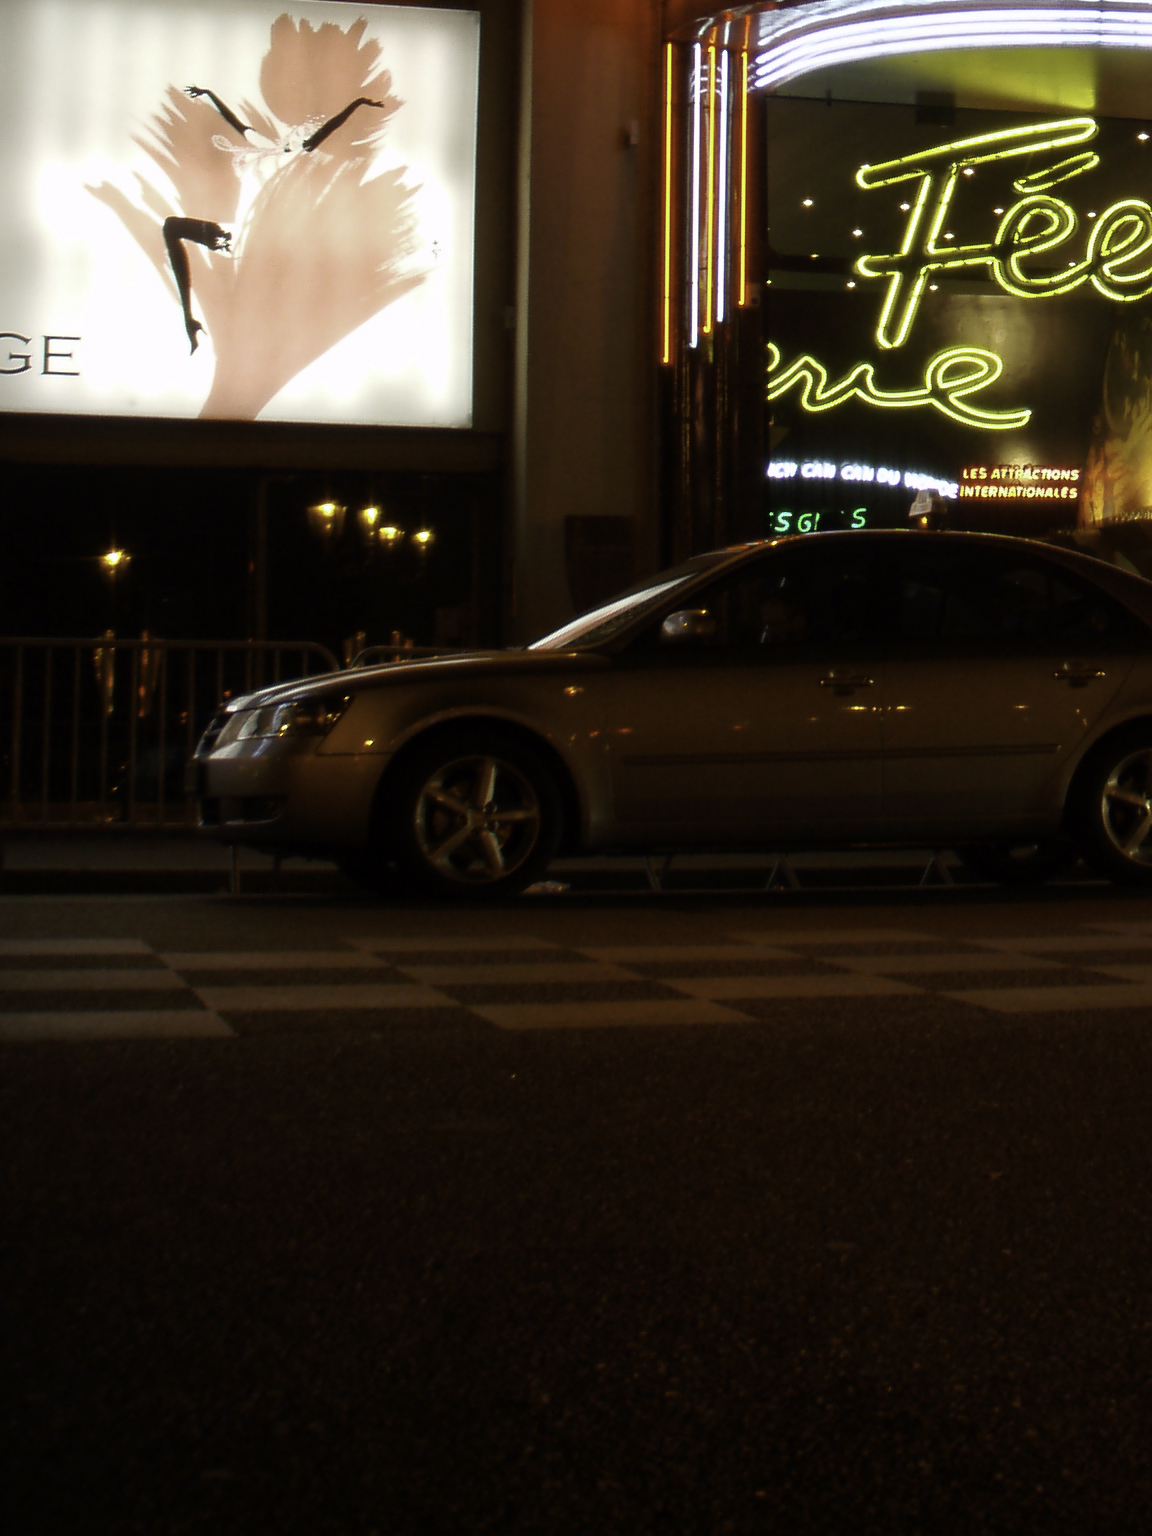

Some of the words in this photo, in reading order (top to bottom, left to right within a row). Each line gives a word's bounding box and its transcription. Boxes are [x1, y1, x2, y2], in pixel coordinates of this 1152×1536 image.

[963, 467, 988, 480] LES
[990, 468, 1080, 481] ATTRACTIONS
[960, 485, 1078, 499] INTERNATIONALES
